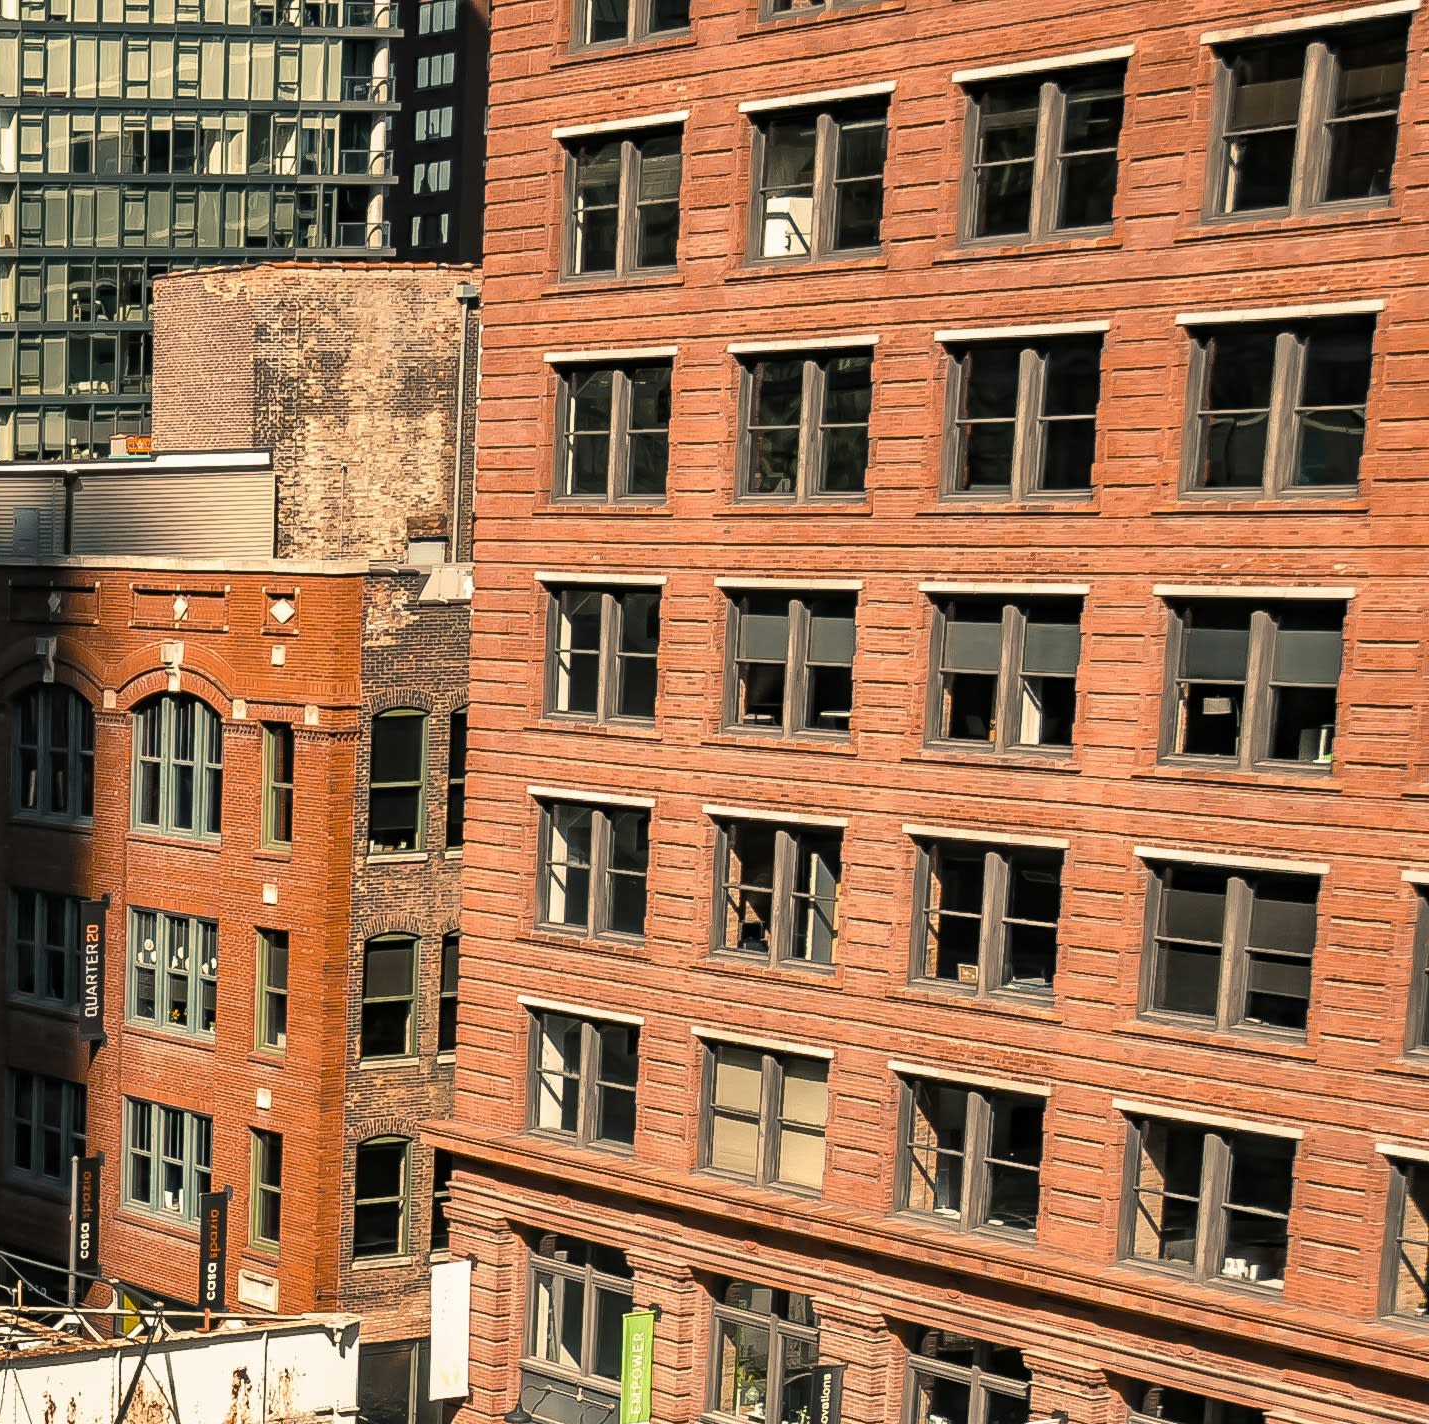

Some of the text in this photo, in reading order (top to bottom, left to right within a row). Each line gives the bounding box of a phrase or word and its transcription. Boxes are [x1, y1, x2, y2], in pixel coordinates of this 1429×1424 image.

[80, 1222, 90, 1259] casa
[206, 1262, 218, 1301] casa
[630, 1332, 645, 1416] EMPOWER
